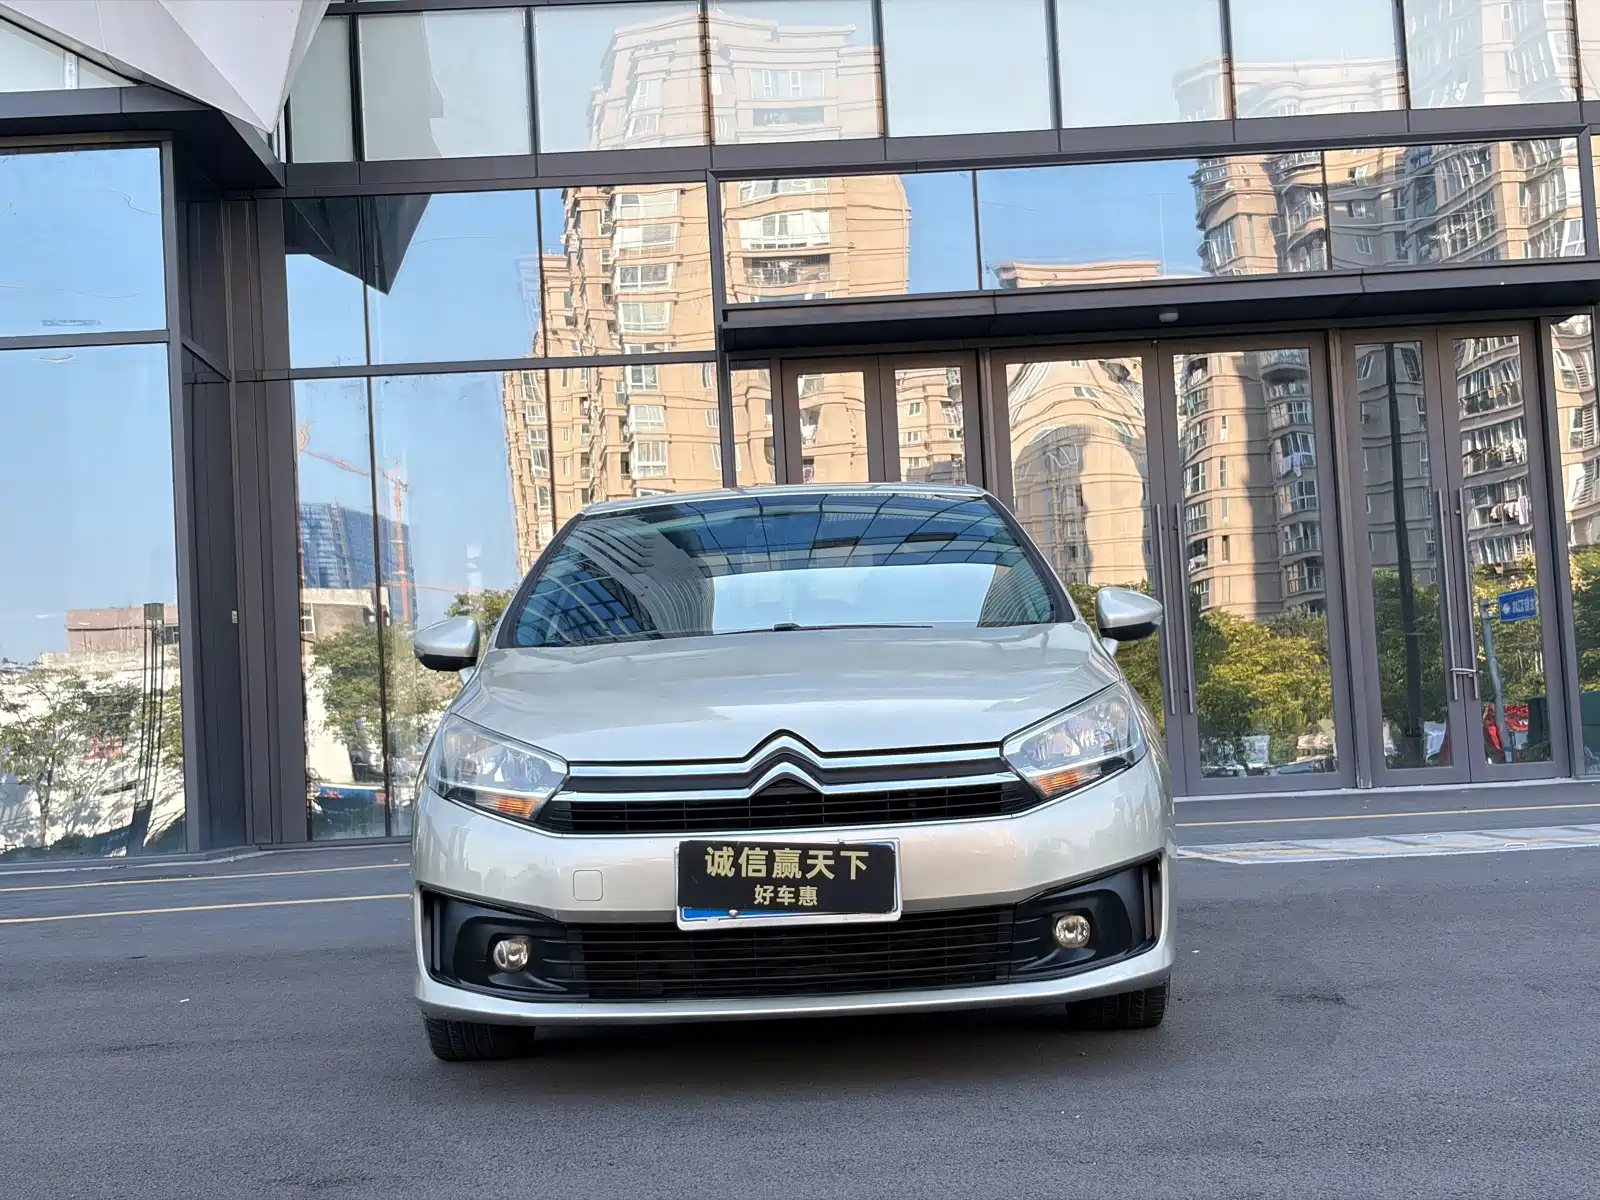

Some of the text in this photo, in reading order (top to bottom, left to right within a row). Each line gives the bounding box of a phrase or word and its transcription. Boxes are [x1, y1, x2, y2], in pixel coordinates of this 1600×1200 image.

[705, 847, 869, 880] 诚信赢天下
[754, 884, 818, 906] 好车惠
